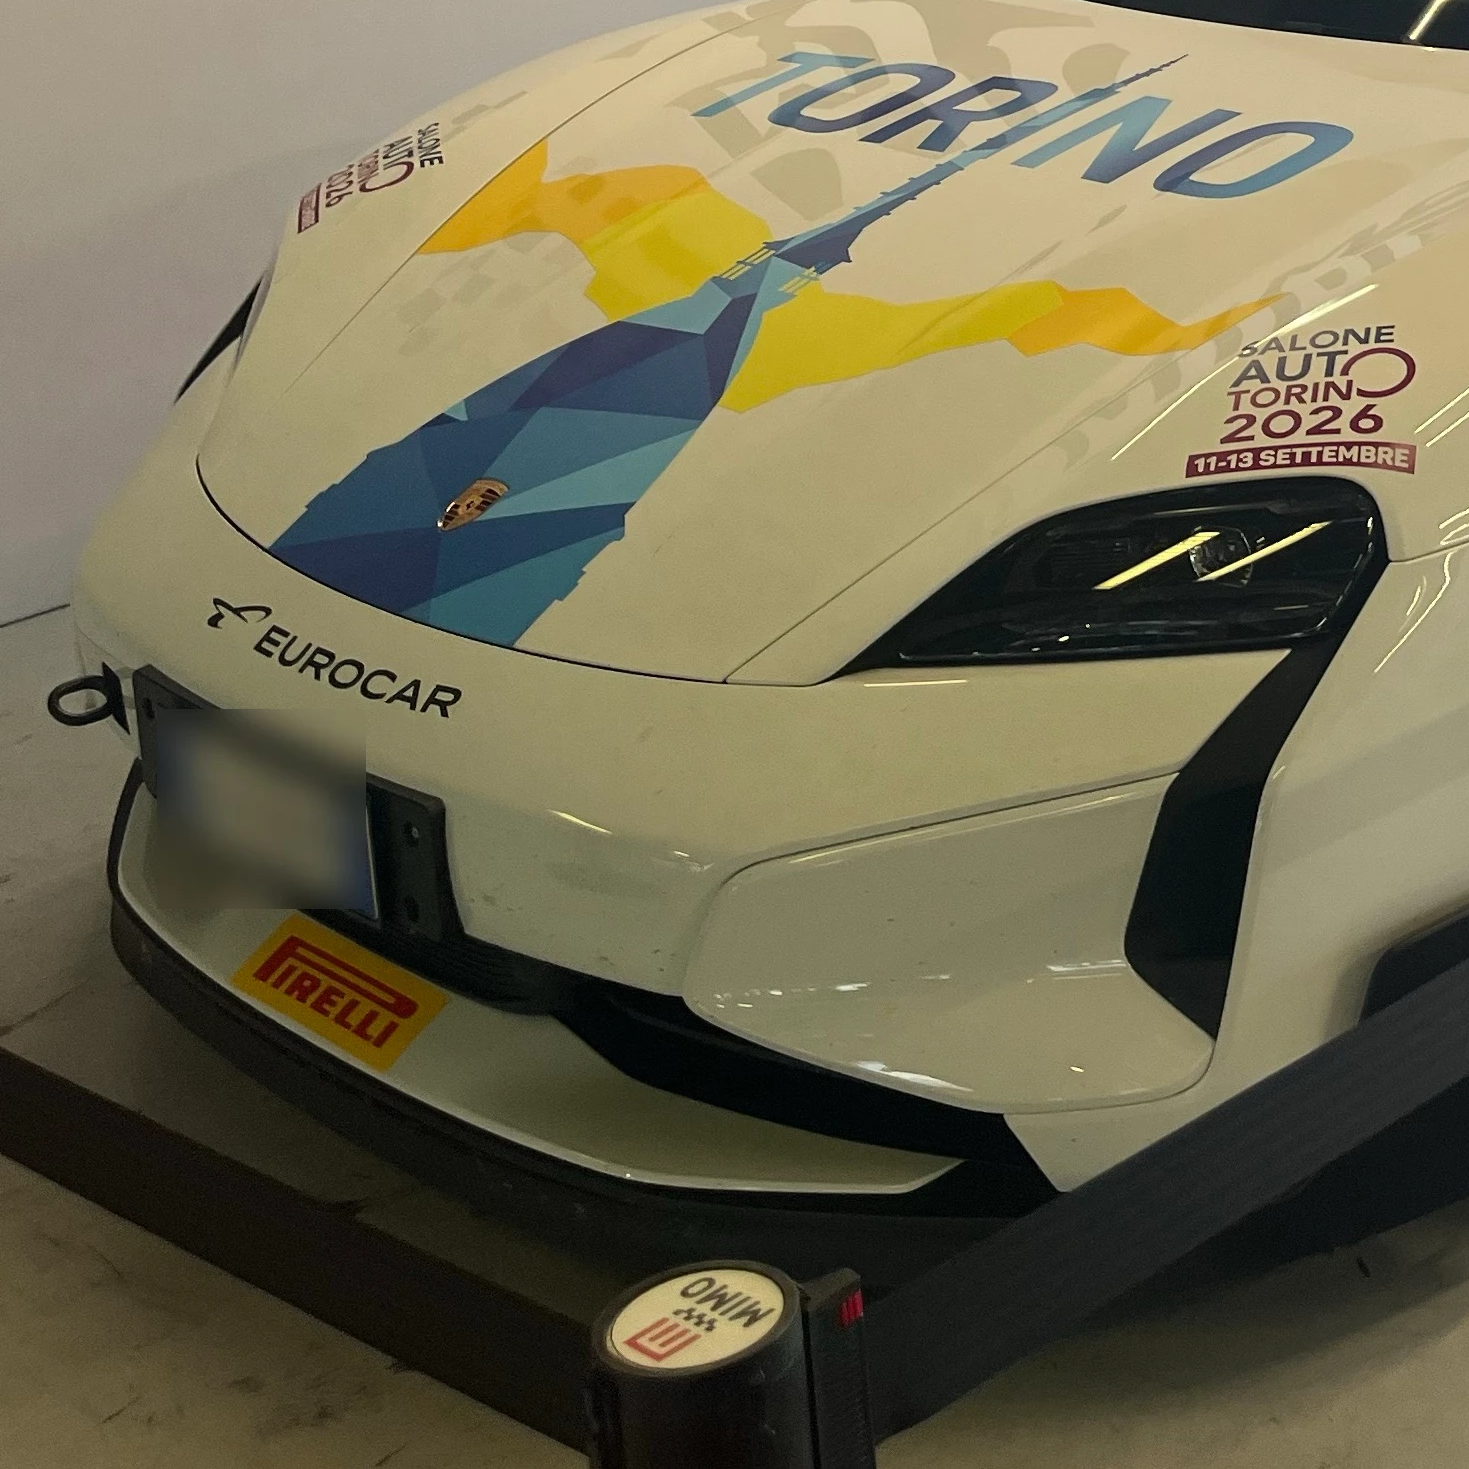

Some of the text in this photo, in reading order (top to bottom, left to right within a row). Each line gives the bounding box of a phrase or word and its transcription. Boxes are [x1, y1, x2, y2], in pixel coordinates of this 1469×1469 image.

[691, 51, 1354, 199] TORINO
[1238, 324, 1396, 358] SALONE
[1219, 403, 1384, 445] 2026
[1194, 445, 1411, 474] 11-13 SETTEMBRE
[253, 624, 463, 719] EUROCAR
[252, 934, 420, 1049] PIRELLI
[679, 1276, 777, 1328] MIMO
